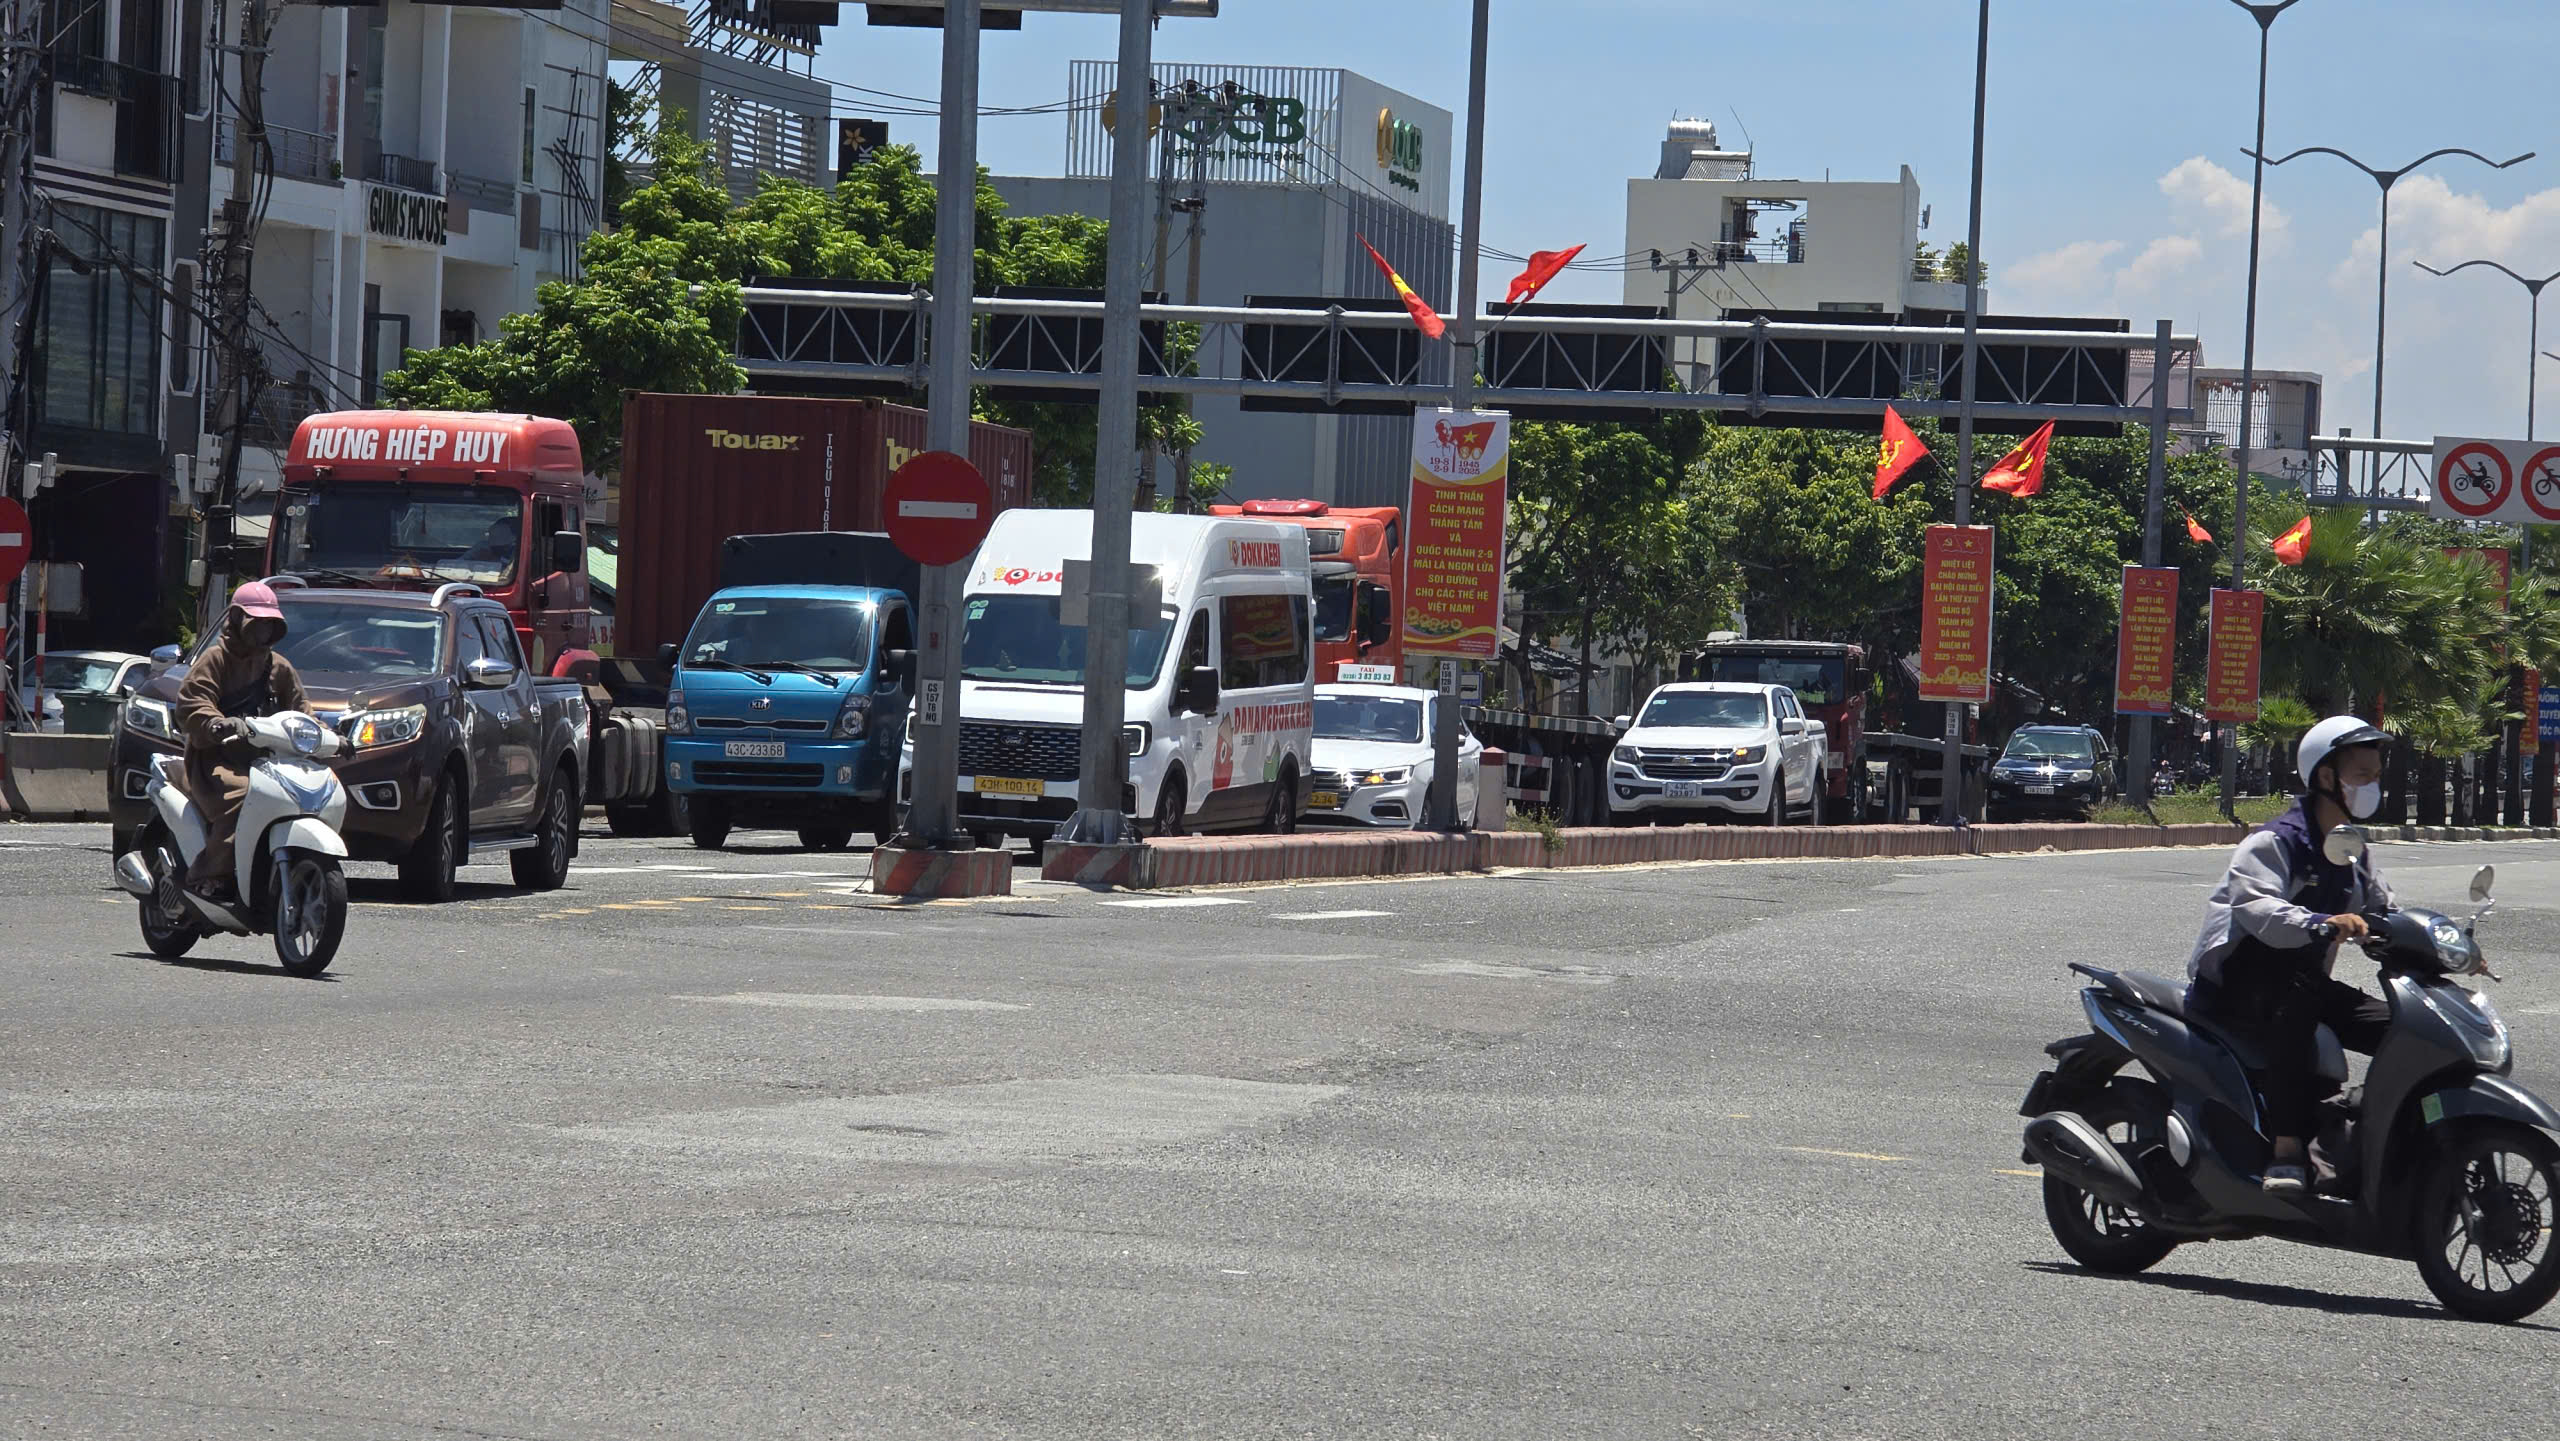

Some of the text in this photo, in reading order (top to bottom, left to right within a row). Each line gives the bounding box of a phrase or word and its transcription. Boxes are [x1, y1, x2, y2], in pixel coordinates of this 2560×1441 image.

[407, 195, 448, 245] HOUSE
[307, 424, 508, 465] HƯNG HIỆP HUY
[825, 433, 833, 481] TGCU
[1430, 457, 1449, 466] 19-8
[1434, 465, 1449, 473] 2-9
[1459, 460, 1480, 468] 1945
[1458, 467, 1480, 475] 2025
[1435, 490, 1457, 500] TINH
[1429, 502, 1455, 514] CÁCH
[1430, 517, 1460, 529] THÁNG
[1240, 541, 1281, 567] DOKKAEBI
[1443, 545, 1475, 557] KHÁNH
[1478, 549, 1493, 558] 2-9
[1415, 587, 1434, 597] CHO
[1436, 587, 1455, 599] CÁC
[1427, 601, 1475, 613] VIỆT NAM!
[928, 683, 938, 692] CS
[926, 693, 939, 702] 157
[752, 701, 767, 709] KIA
[727, 742, 783, 756] 43C-233.68
[980, 779, 1037, 793] 43H-100.14
